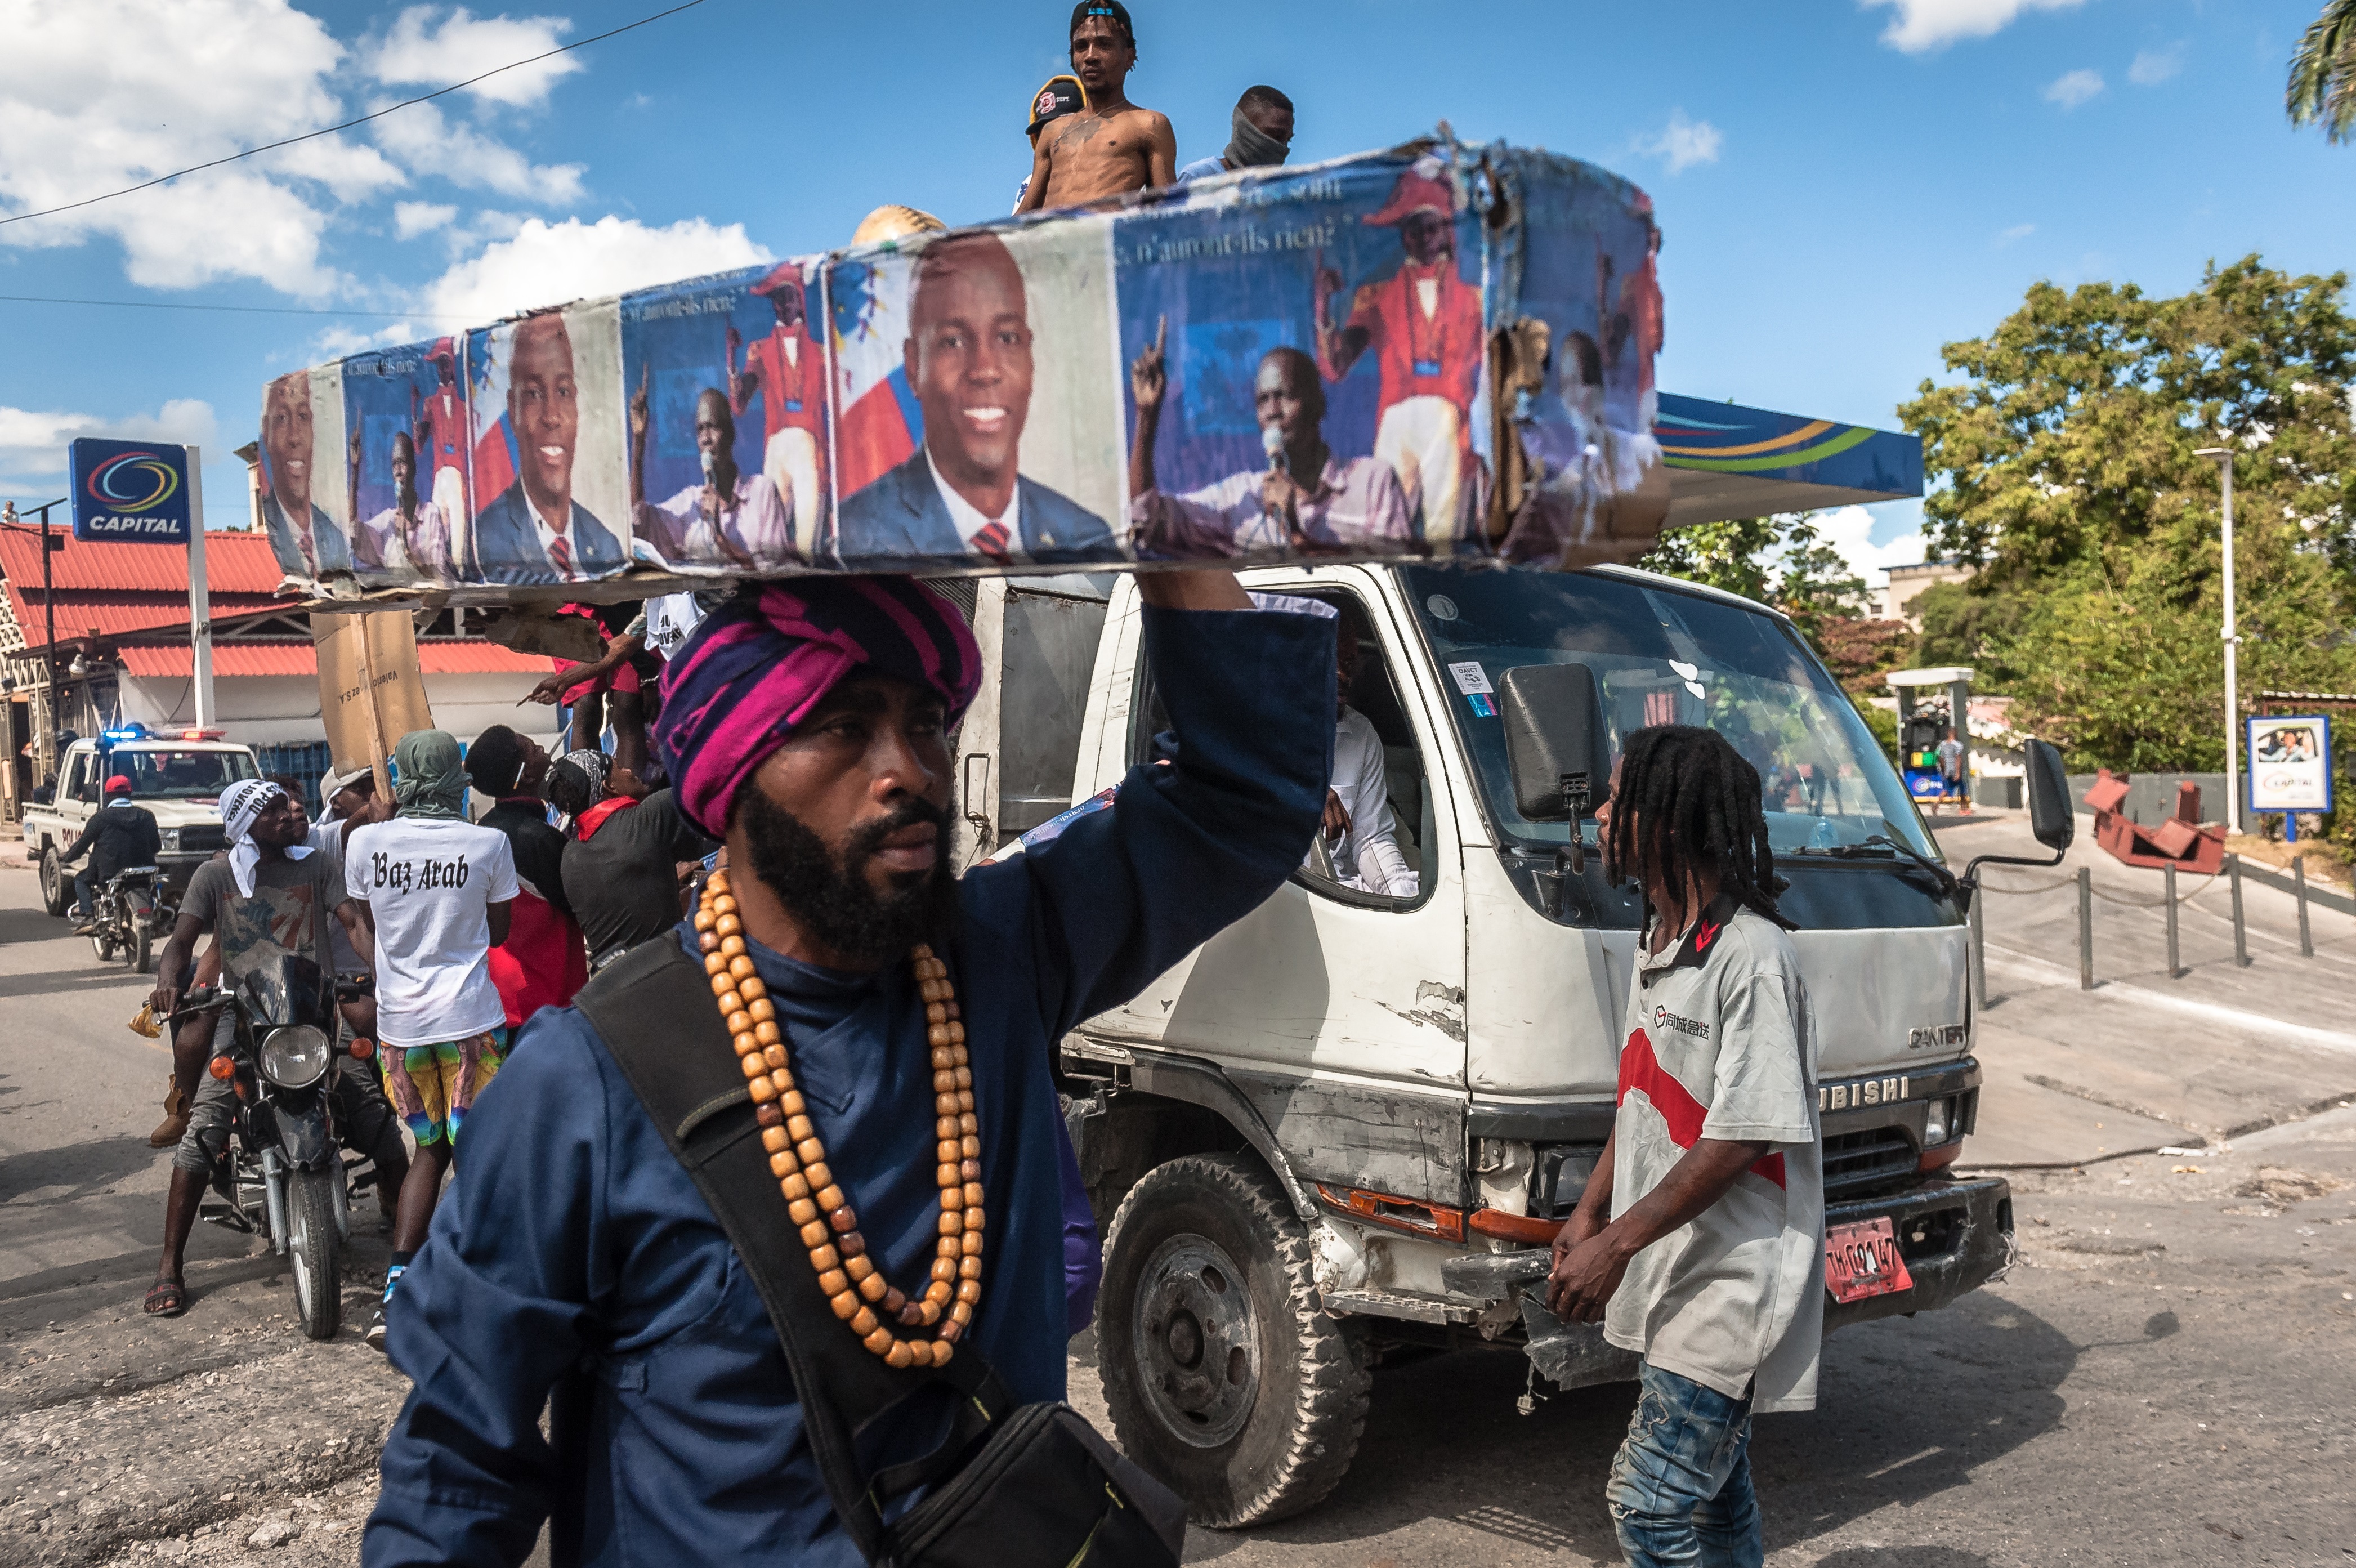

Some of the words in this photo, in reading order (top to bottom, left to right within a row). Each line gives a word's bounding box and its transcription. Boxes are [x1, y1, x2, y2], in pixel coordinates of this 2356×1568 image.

[89, 515, 181, 534] CAPITAL
[416, 854, 468, 890] Arab
[1666, 1013, 1710, 1040] 同城急送
[1908, 1024, 1964, 1048] CANTER
